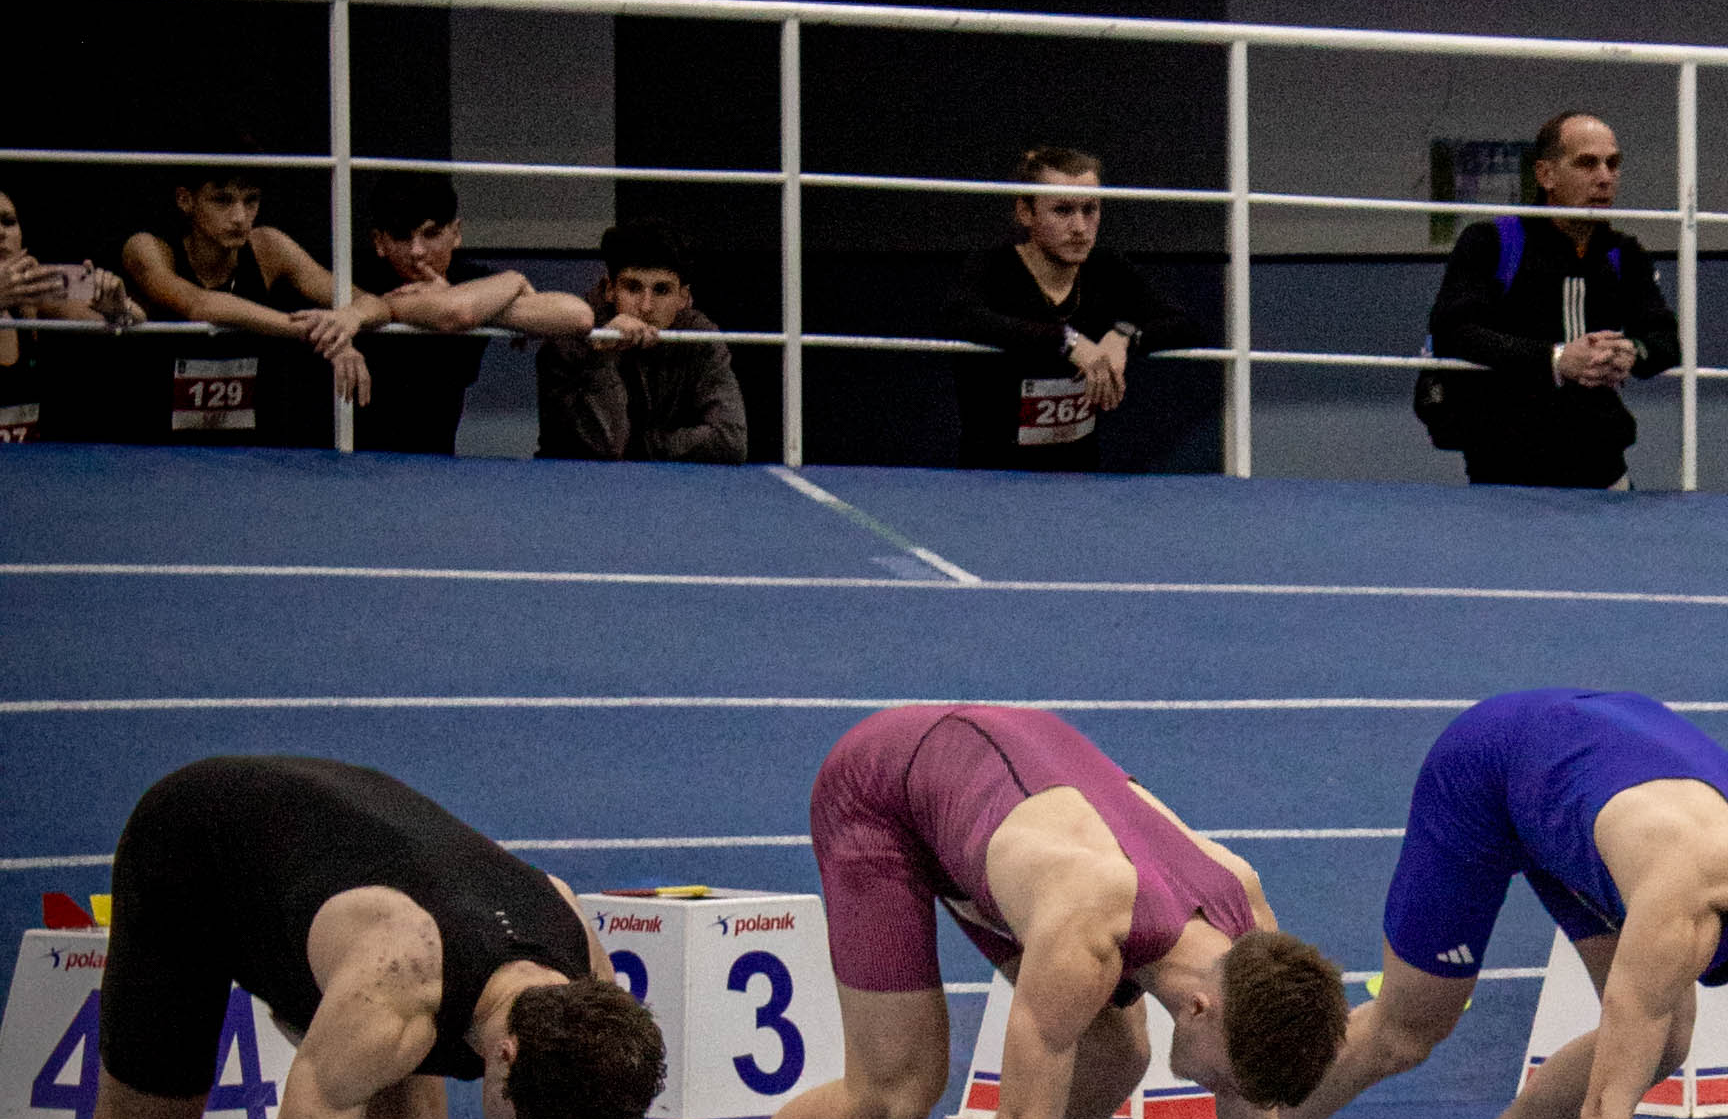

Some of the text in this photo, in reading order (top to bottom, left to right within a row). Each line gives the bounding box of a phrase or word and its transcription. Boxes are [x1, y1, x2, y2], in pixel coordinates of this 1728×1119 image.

[189, 380, 244, 408] 129
[1036, 396, 1092, 425] 262
[608, 914, 663, 934] polanik
[734, 912, 796, 936] polanik
[727, 950, 805, 1096] 3
